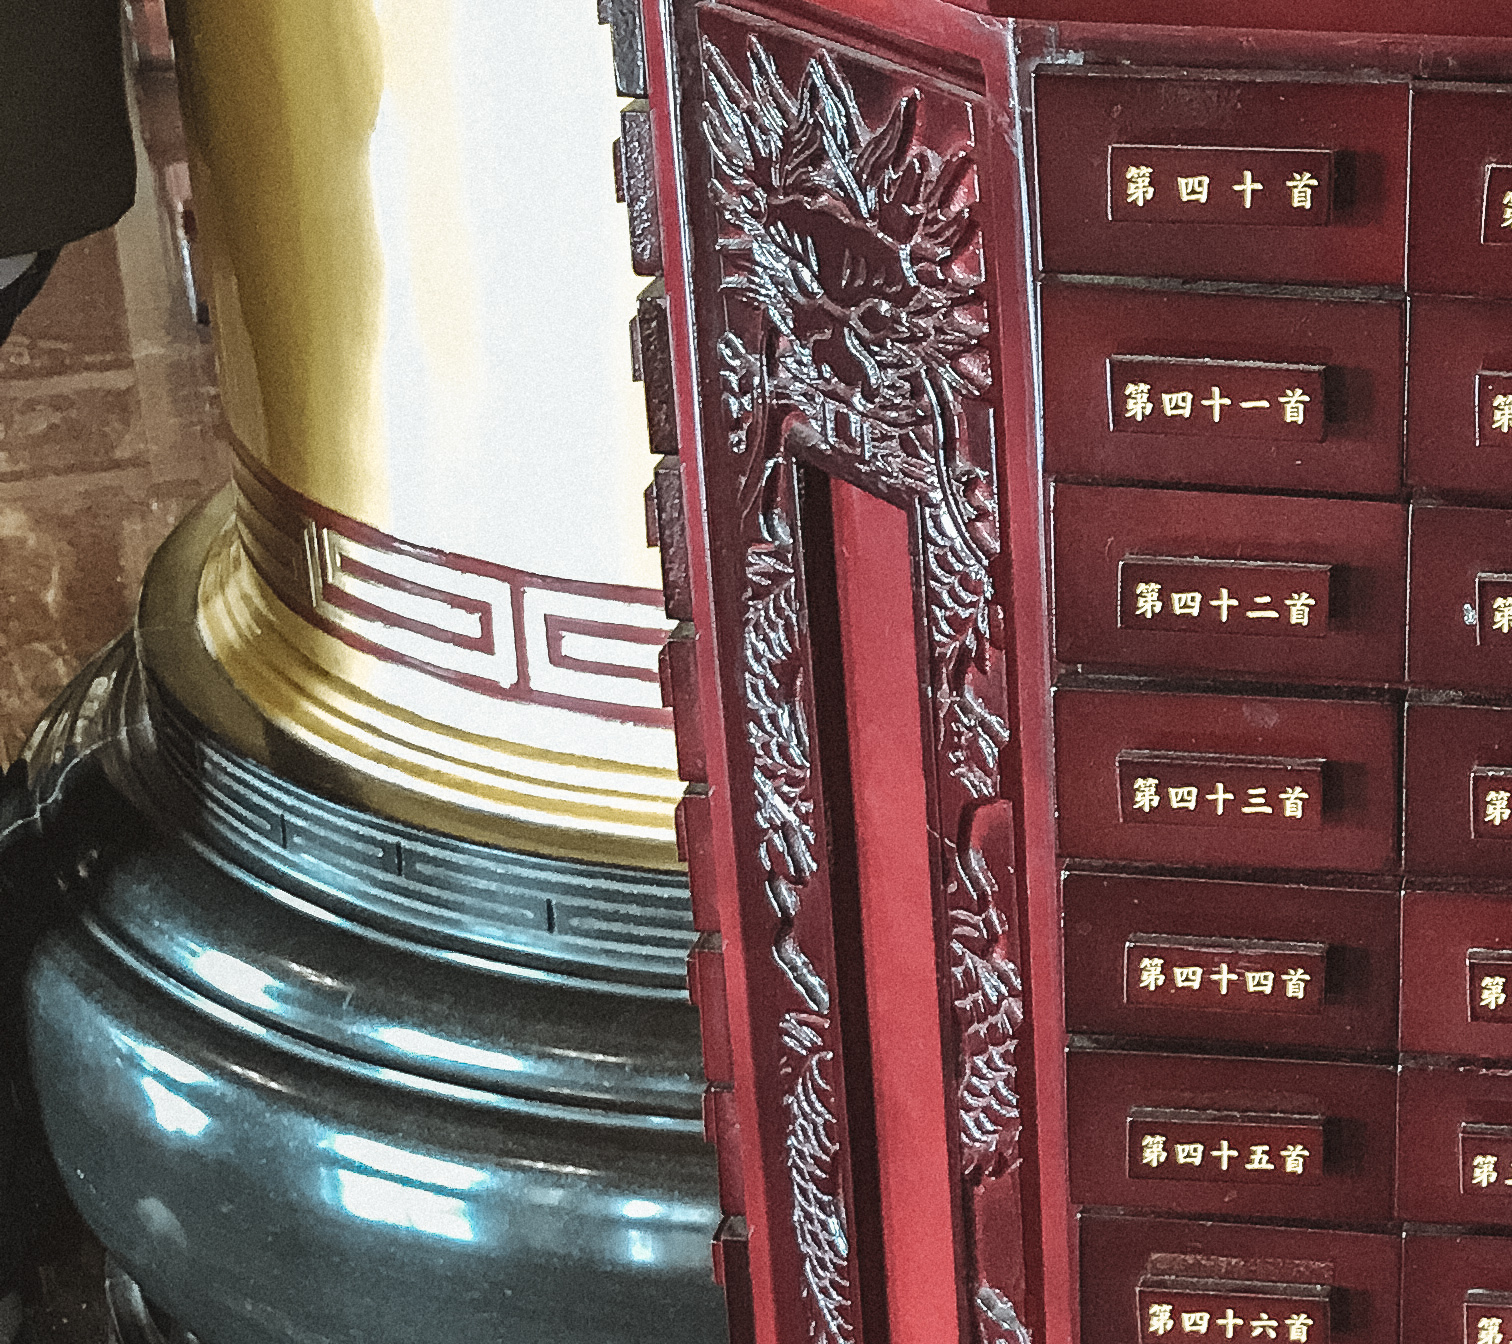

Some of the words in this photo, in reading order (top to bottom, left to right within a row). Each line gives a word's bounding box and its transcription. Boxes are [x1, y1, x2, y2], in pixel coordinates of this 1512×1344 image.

[1125, 165, 1319, 210] 第四十首
[1123, 382, 1311, 425] 第四十一首
[1135, 582, 1316, 627] 第四十二首
[1132, 777, 1309, 819] 第四十三首
[1139, 958, 1311, 1000] 第四十四首
[1141, 1134, 1310, 1175] 第四十五首
[1148, 1303, 1314, 1343] 第四十六首
